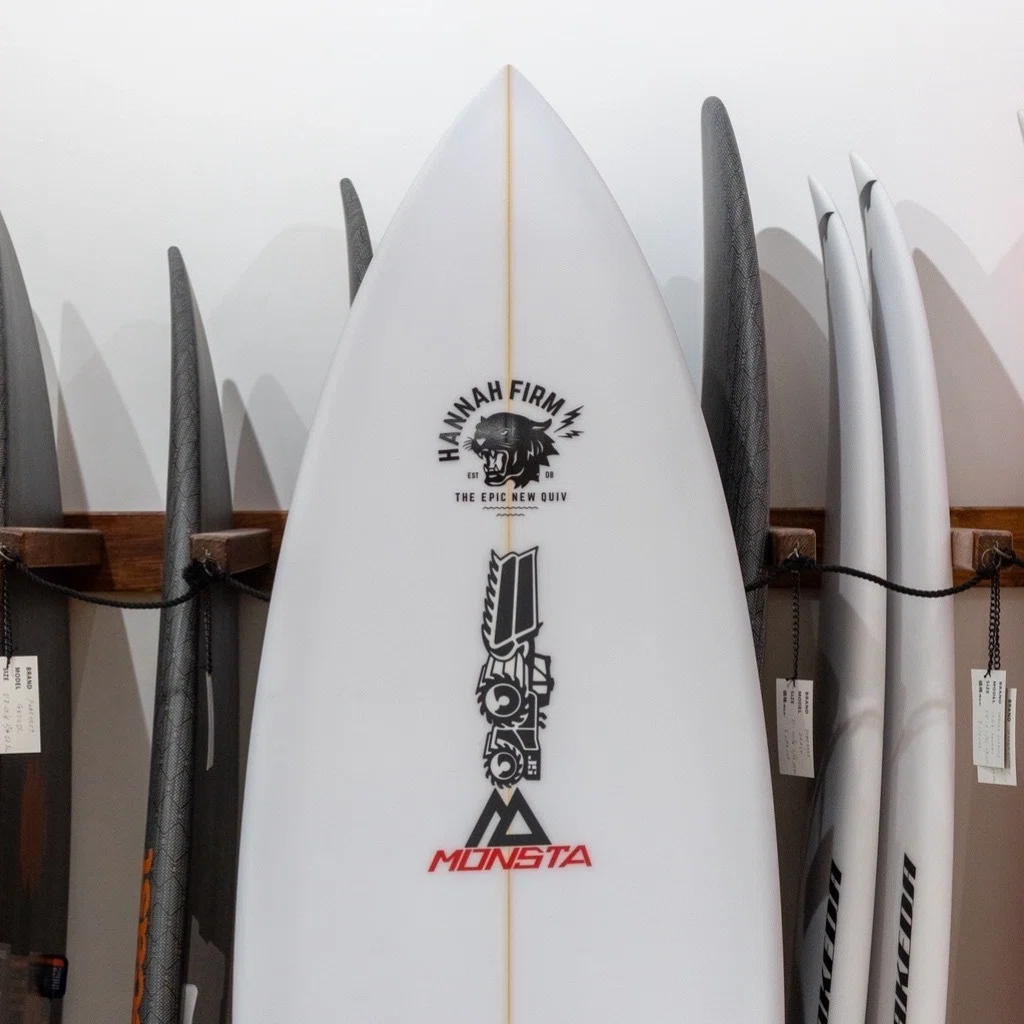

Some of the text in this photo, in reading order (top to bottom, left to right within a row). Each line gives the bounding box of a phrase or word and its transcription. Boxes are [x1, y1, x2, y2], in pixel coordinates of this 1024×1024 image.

[438, 379, 566, 462] HANNAH FIRM
[455, 492, 567, 502] THE EPIC NEW QUIV
[527, 755, 537, 775] JS
[428, 845, 592, 872] MONSTA
